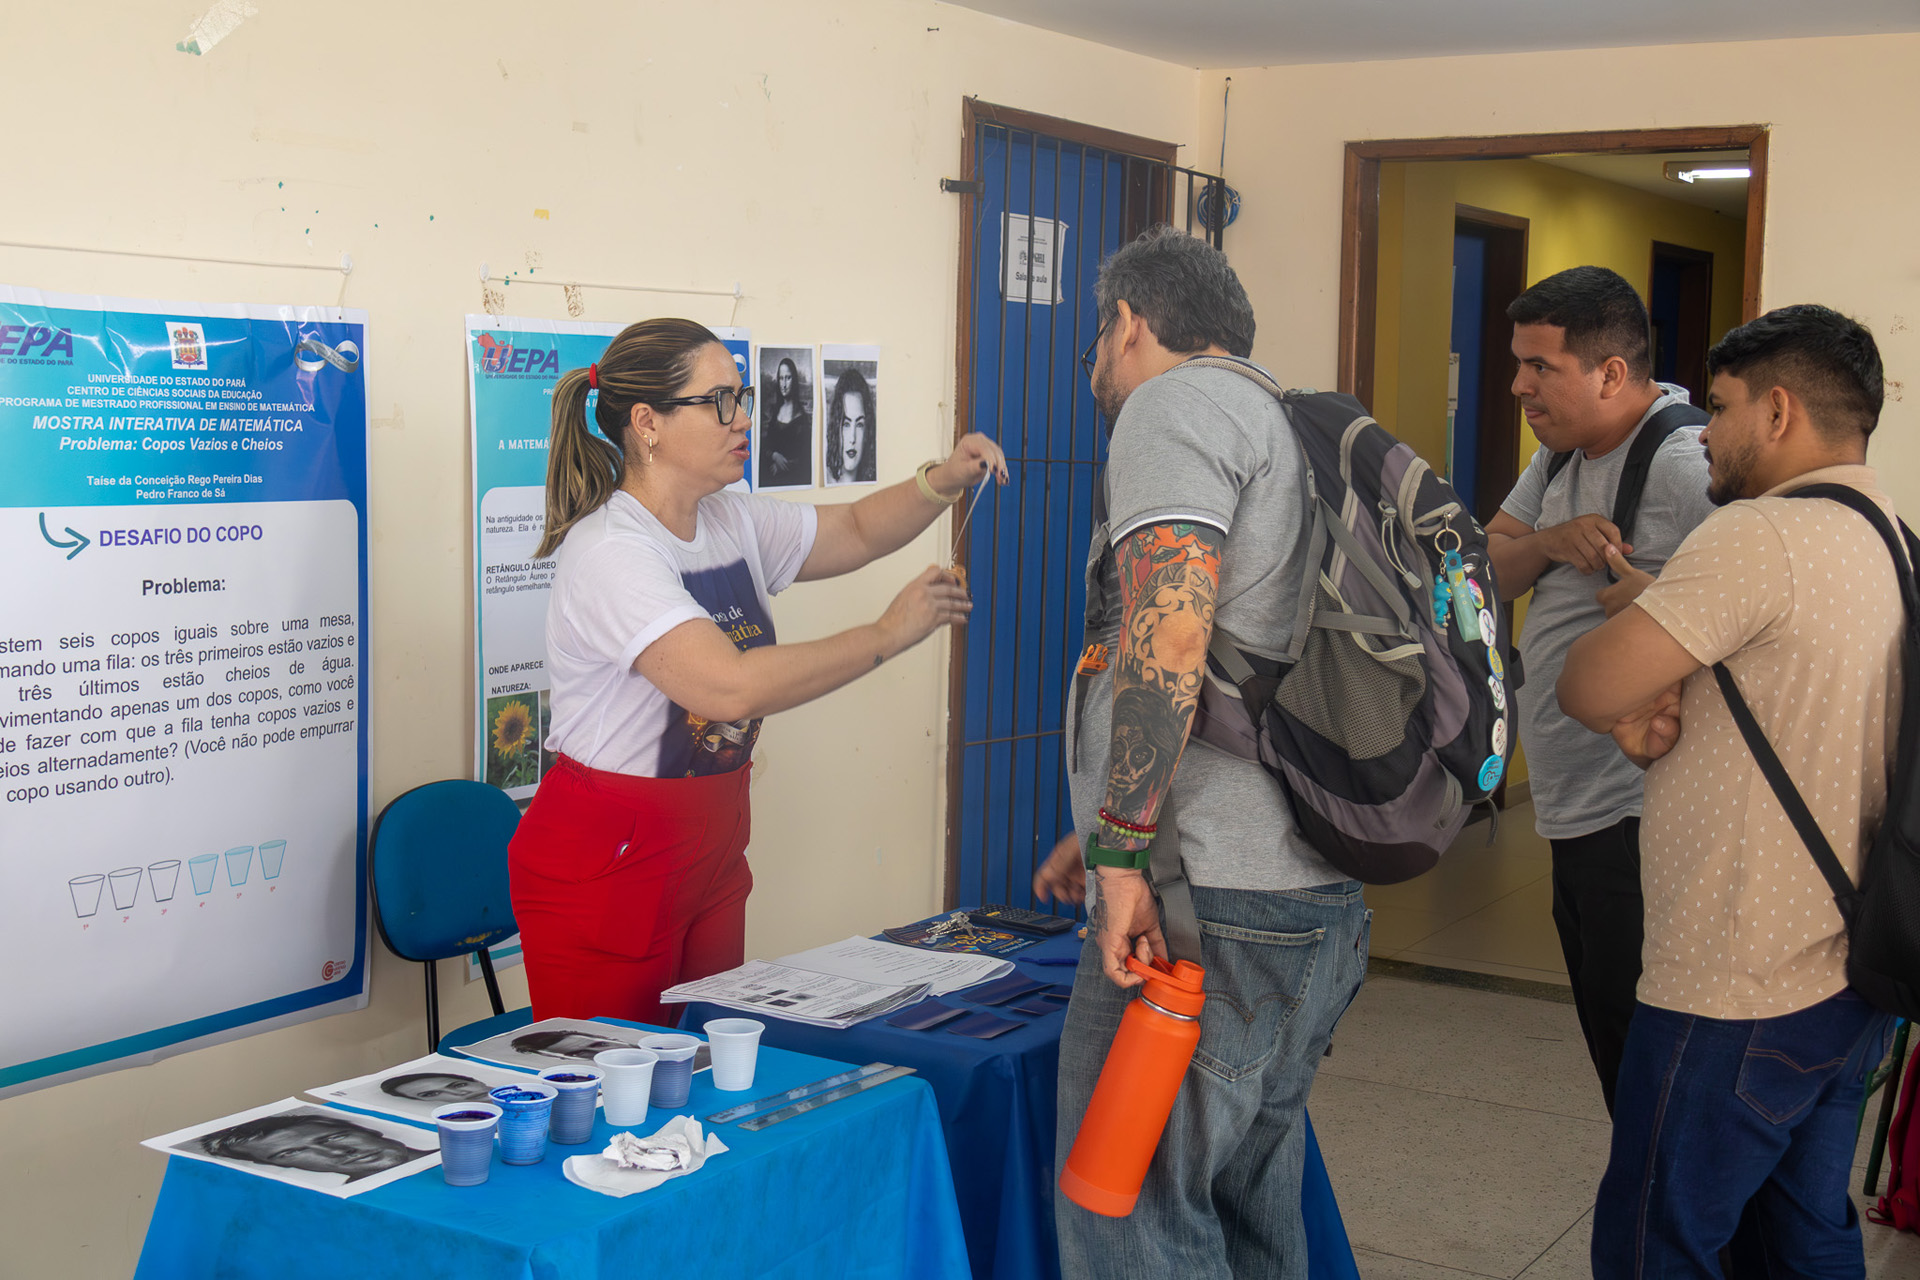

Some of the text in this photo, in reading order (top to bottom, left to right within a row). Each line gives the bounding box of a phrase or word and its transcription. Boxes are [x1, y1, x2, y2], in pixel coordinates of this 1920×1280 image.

[57, 358, 74, 366] PARÁ
[485, 346, 559, 373] UEPA
[88, 374, 246, 388] UNIVERSIDADE DO ESTADO DO PARÁ
[67, 386, 263, 401] CENTRO DE CIÊNCIAS SOCIAIS DA EDUCAÇÃO
[0, 397, 315, 412] PROGRAMA DE MESTRADO PROFISSIONAL EM ENSINO DE MATEMÁTICA
[33, 415, 304, 432] MOSTRA INTERATIVA DE MATEMÁTICA
[59, 436, 284, 454] Problema: Copos Vazios e Cheios
[498, 440, 505, 450] A
[86, 473, 263, 488] Taíse da Conceição Rego Pereira Dias
[136, 487, 226, 499] Pedro Franco de Sá
[486, 514, 543, 525] Na antiguidade os
[518, 523, 529, 532] Ela
[532, 521, 537, 531] é
[99, 525, 263, 547] DESAFIO DO COPO
[486, 562, 530, 574] RETÂNGULO
[486, 576, 492, 585] O
[495, 573, 527, 584] Retângulo
[529, 570, 548, 581] Áureo
[142, 577, 226, 596] Problema:
[486, 585, 515, 596] retângulo
[728, 604, 744, 620] de
[59, 632, 95, 649] seis
[111, 630, 160, 648] copos
[174, 623, 218, 644] iguais
[230, 620, 269, 636] sobre
[281, 618, 309, 632] uma
[320, 613, 355, 628] mesa,
[62, 659, 100, 673] uma
[106, 654, 135, 670] fila:
[141, 654, 160, 667] os
[165, 649, 193, 665] três
[199, 644, 264, 666] primeiros
[268, 639, 303, 655] estão
[306, 635, 344, 651] vazios
[347, 635, 355, 646] e
[488, 660, 544, 676] ONDE APARECE
[18, 656, 355, 702] três últimos estão cheios de água.
[491, 682, 532, 695] NATUREZA:
[110, 700, 170, 720] apenas
[176, 697, 200, 710] um
[206, 691, 232, 707] dos
[238, 687, 282, 705] copos,
[288, 682, 322, 697] como
[327, 675, 355, 691] você
[26, 734, 72, 750] fazer
[80, 729, 117, 745] com
[126, 725, 156, 743] que
[164, 723, 173, 735] a
[182, 717, 203, 733] fila
[211, 711, 250, 730] tenha
[257, 707, 297, 724] copos
[303, 699, 341, 717] vazios
[347, 699, 355, 710] e
[37, 741, 178, 775] alternadamente?
[184, 736, 226, 760] (Você
[232, 733, 257, 749] não
[262, 727, 295, 748] pode
[300, 719, 355, 740] empurrar
[6, 766, 174, 804] copo usando outro).
